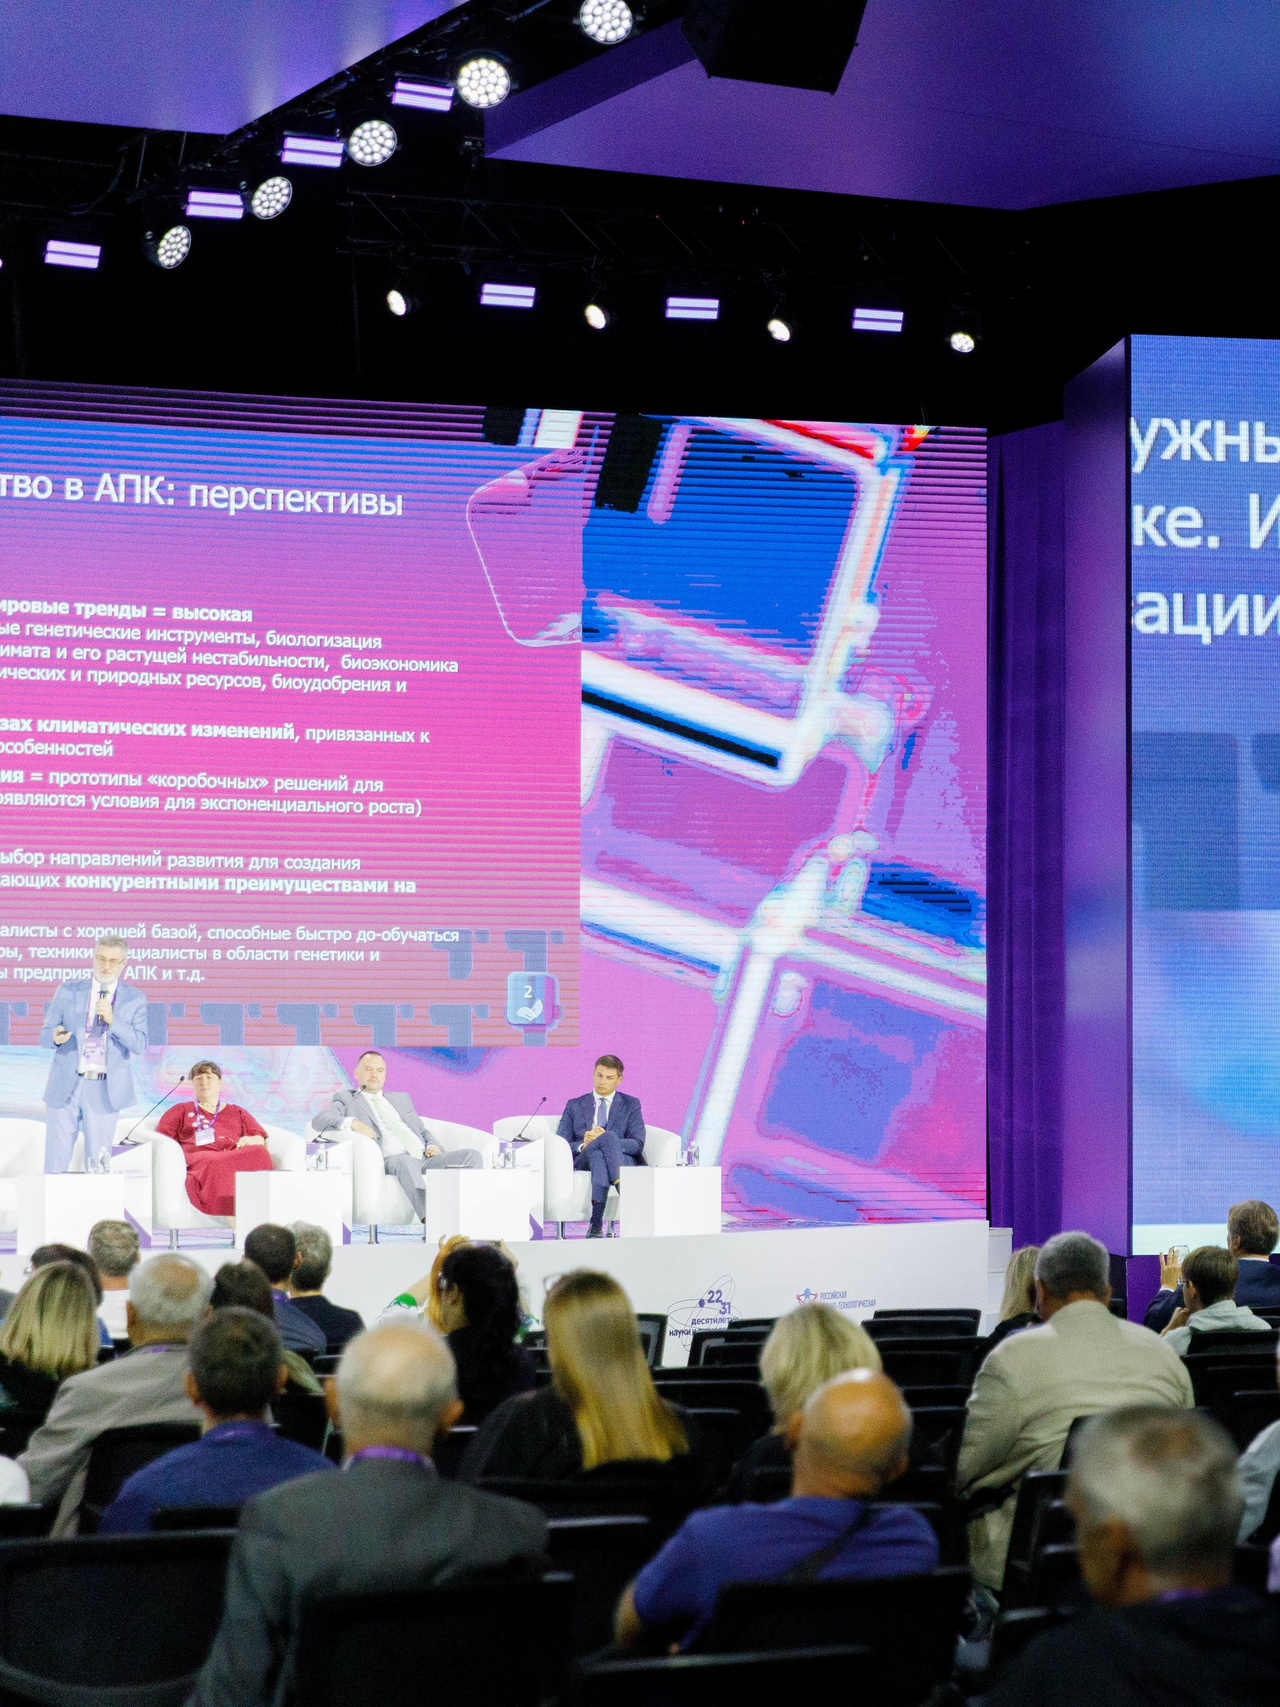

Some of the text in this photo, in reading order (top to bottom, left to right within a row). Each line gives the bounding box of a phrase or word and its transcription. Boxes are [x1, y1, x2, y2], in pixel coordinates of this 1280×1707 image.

[65, 478, 83, 500] в
[94, 473, 174, 505] АПК:
[190, 485, 402, 515] перспективы
[1133, 505, 1219, 548] ке.
[0, 600, 69, 615] ировые
[74, 603, 147, 619] тренды
[172, 607, 252, 622] высокая
[25, 624, 141, 640] генетические
[146, 629, 260, 649] инструменты,
[266, 631, 382, 650] биологизация
[0, 645, 458, 672] имата и его растущей нестабильности, биоэкономика
[0, 667, 406, 694] ических и природных ресурсов, биоудобрения и
[0, 718, 430, 743] зах климатических изменений, привязанных к
[0, 770, 24, 783] ия
[49, 772, 142, 787] прототипы
[148, 774, 268, 790] «коробочных»
[274, 775, 348, 793] решений
[353, 780, 383, 793] для
[91, 795, 159, 810] условия
[164, 797, 196, 811] для
[201, 798, 364, 813] экспоненциального
[368, 799, 421, 817] роста)
[0, 847, 361, 872] ыбор направлений развития для создания
[0, 874, 416, 894] ающих конкурентными преимуществами на
[0, 923, 459, 945] алисты с хорошей базой, способные быстро до-обучаться
[29, 948, 94, 959] техники
[126, 949, 207, 962] ециалисты
[213, 950, 222, 960] в
[227, 946, 289, 962] области
[294, 950, 364, 962] генетики
[369, 951, 379, 961] и
[13, 967, 95, 983] предприя
[124, 966, 158, 981] АПК
[162, 969, 172, 980] и
[177, 970, 205, 983] т.д.
[524, 985, 533, 998] 2
[707, 1290, 723, 1303] 22
[719, 1302, 731, 1315] 31
[669, 1329, 691, 1338] науки
